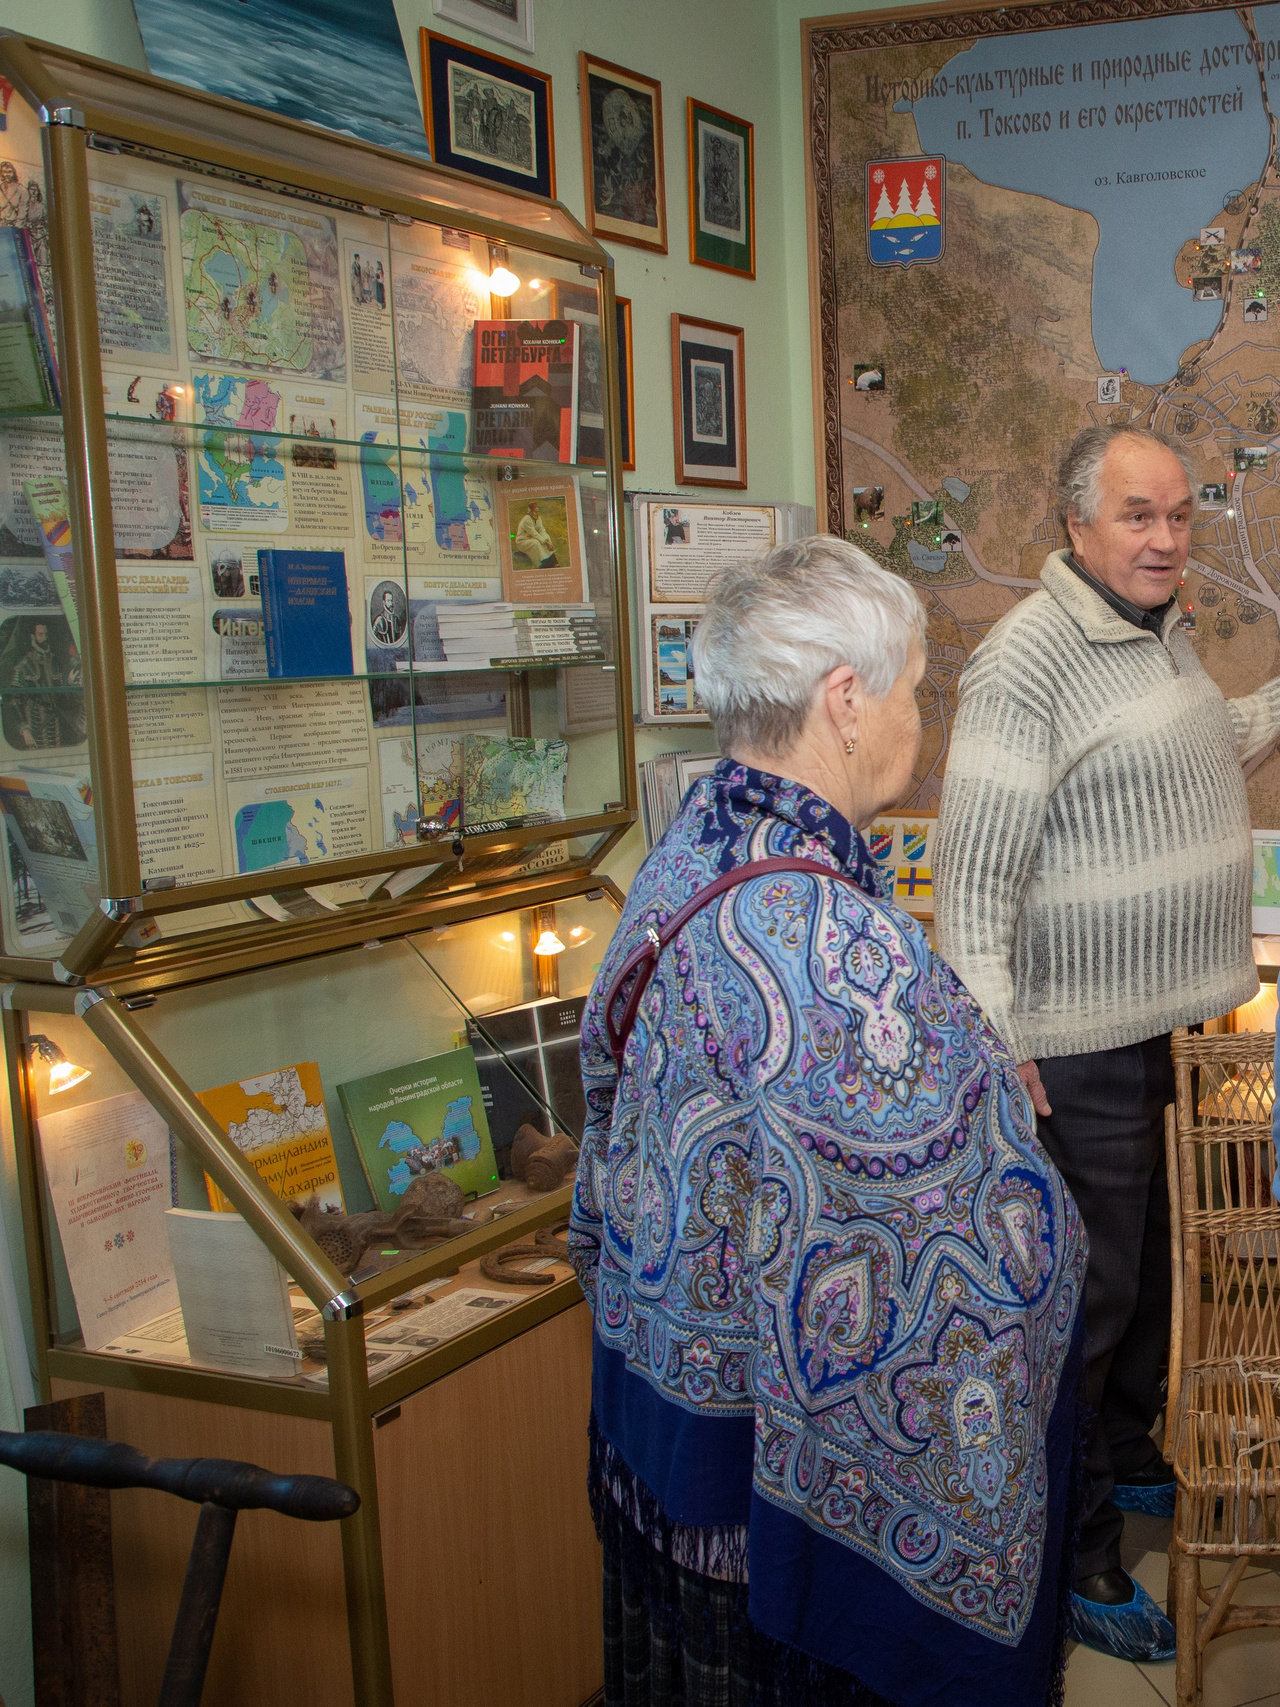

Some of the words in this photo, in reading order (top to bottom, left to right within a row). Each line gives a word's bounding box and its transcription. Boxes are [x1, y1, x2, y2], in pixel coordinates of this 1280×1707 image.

[865, 63, 1064, 108] Историко-культурные
[1072, 61, 1083, 83] и
[1091, 50, 1191, 90] природные
[957, 120, 972, 140] п.
[979, 108, 1051, 138] Токсово
[1059, 110, 1070, 130] и
[1078, 106, 1106, 129] его
[1115, 85, 1243, 132] окрестностей
[1094, 176, 1113, 187] оз.
[1116, 167, 1207, 185] Кавголовское
[481, 330, 517, 348] ОГНИ
[480, 346, 562, 364] ПЕТЕРБУРГА
[361, 404, 391, 416] ГРАНИЦА
[475, 410, 534, 429] PIETARIN
[475, 428, 517, 446] VALOT
[1234, 497, 1251, 560] Ленинградское
[1197, 563, 1206, 573] ул.
[1207, 568, 1250, 596] Дорожников
[218, 686, 235, 695] Герб
[921, 689, 955, 699] Сярьги
[263, 694, 278, 702] XVII
[220, 704, 267, 716] символизирует
[272, 703, 287, 711] поля
[222, 716, 245, 725] полоса
[256, 714, 275, 723] Неву,
[277, 712, 303, 720] красные
[307, 710, 326, 719] зубцы
[223, 725, 250, 736] которой
[223, 736, 259, 746] крепостей.
[269, 732, 293, 742] Первое
[351, 726, 367, 736] герба
[262, 753, 280, 762] герба
[230, 766, 243, 775] 1581
[243, 765, 257, 774] году
[263, 762, 290, 771] хронике
[163, 773, 204, 785] ТОКСОВЕ
[141, 797, 184, 809] Токсовский
[182, 812, 209, 823] приход
[166, 831, 205, 843] шведского
[251, 836, 282, 846] ШВЕЦИЯ
[148, 863, 184, 875] Каменная
[186, 867, 216, 878] церковь
[389, 1084, 412, 1096] Очерки
[412, 1075, 438, 1089] истории
[368, 1100, 395, 1113] народов
[394, 1084, 440, 1106] Ленинградской
[440, 1078, 464, 1091] области
[264, 1344, 301, 1358] 10106000672
